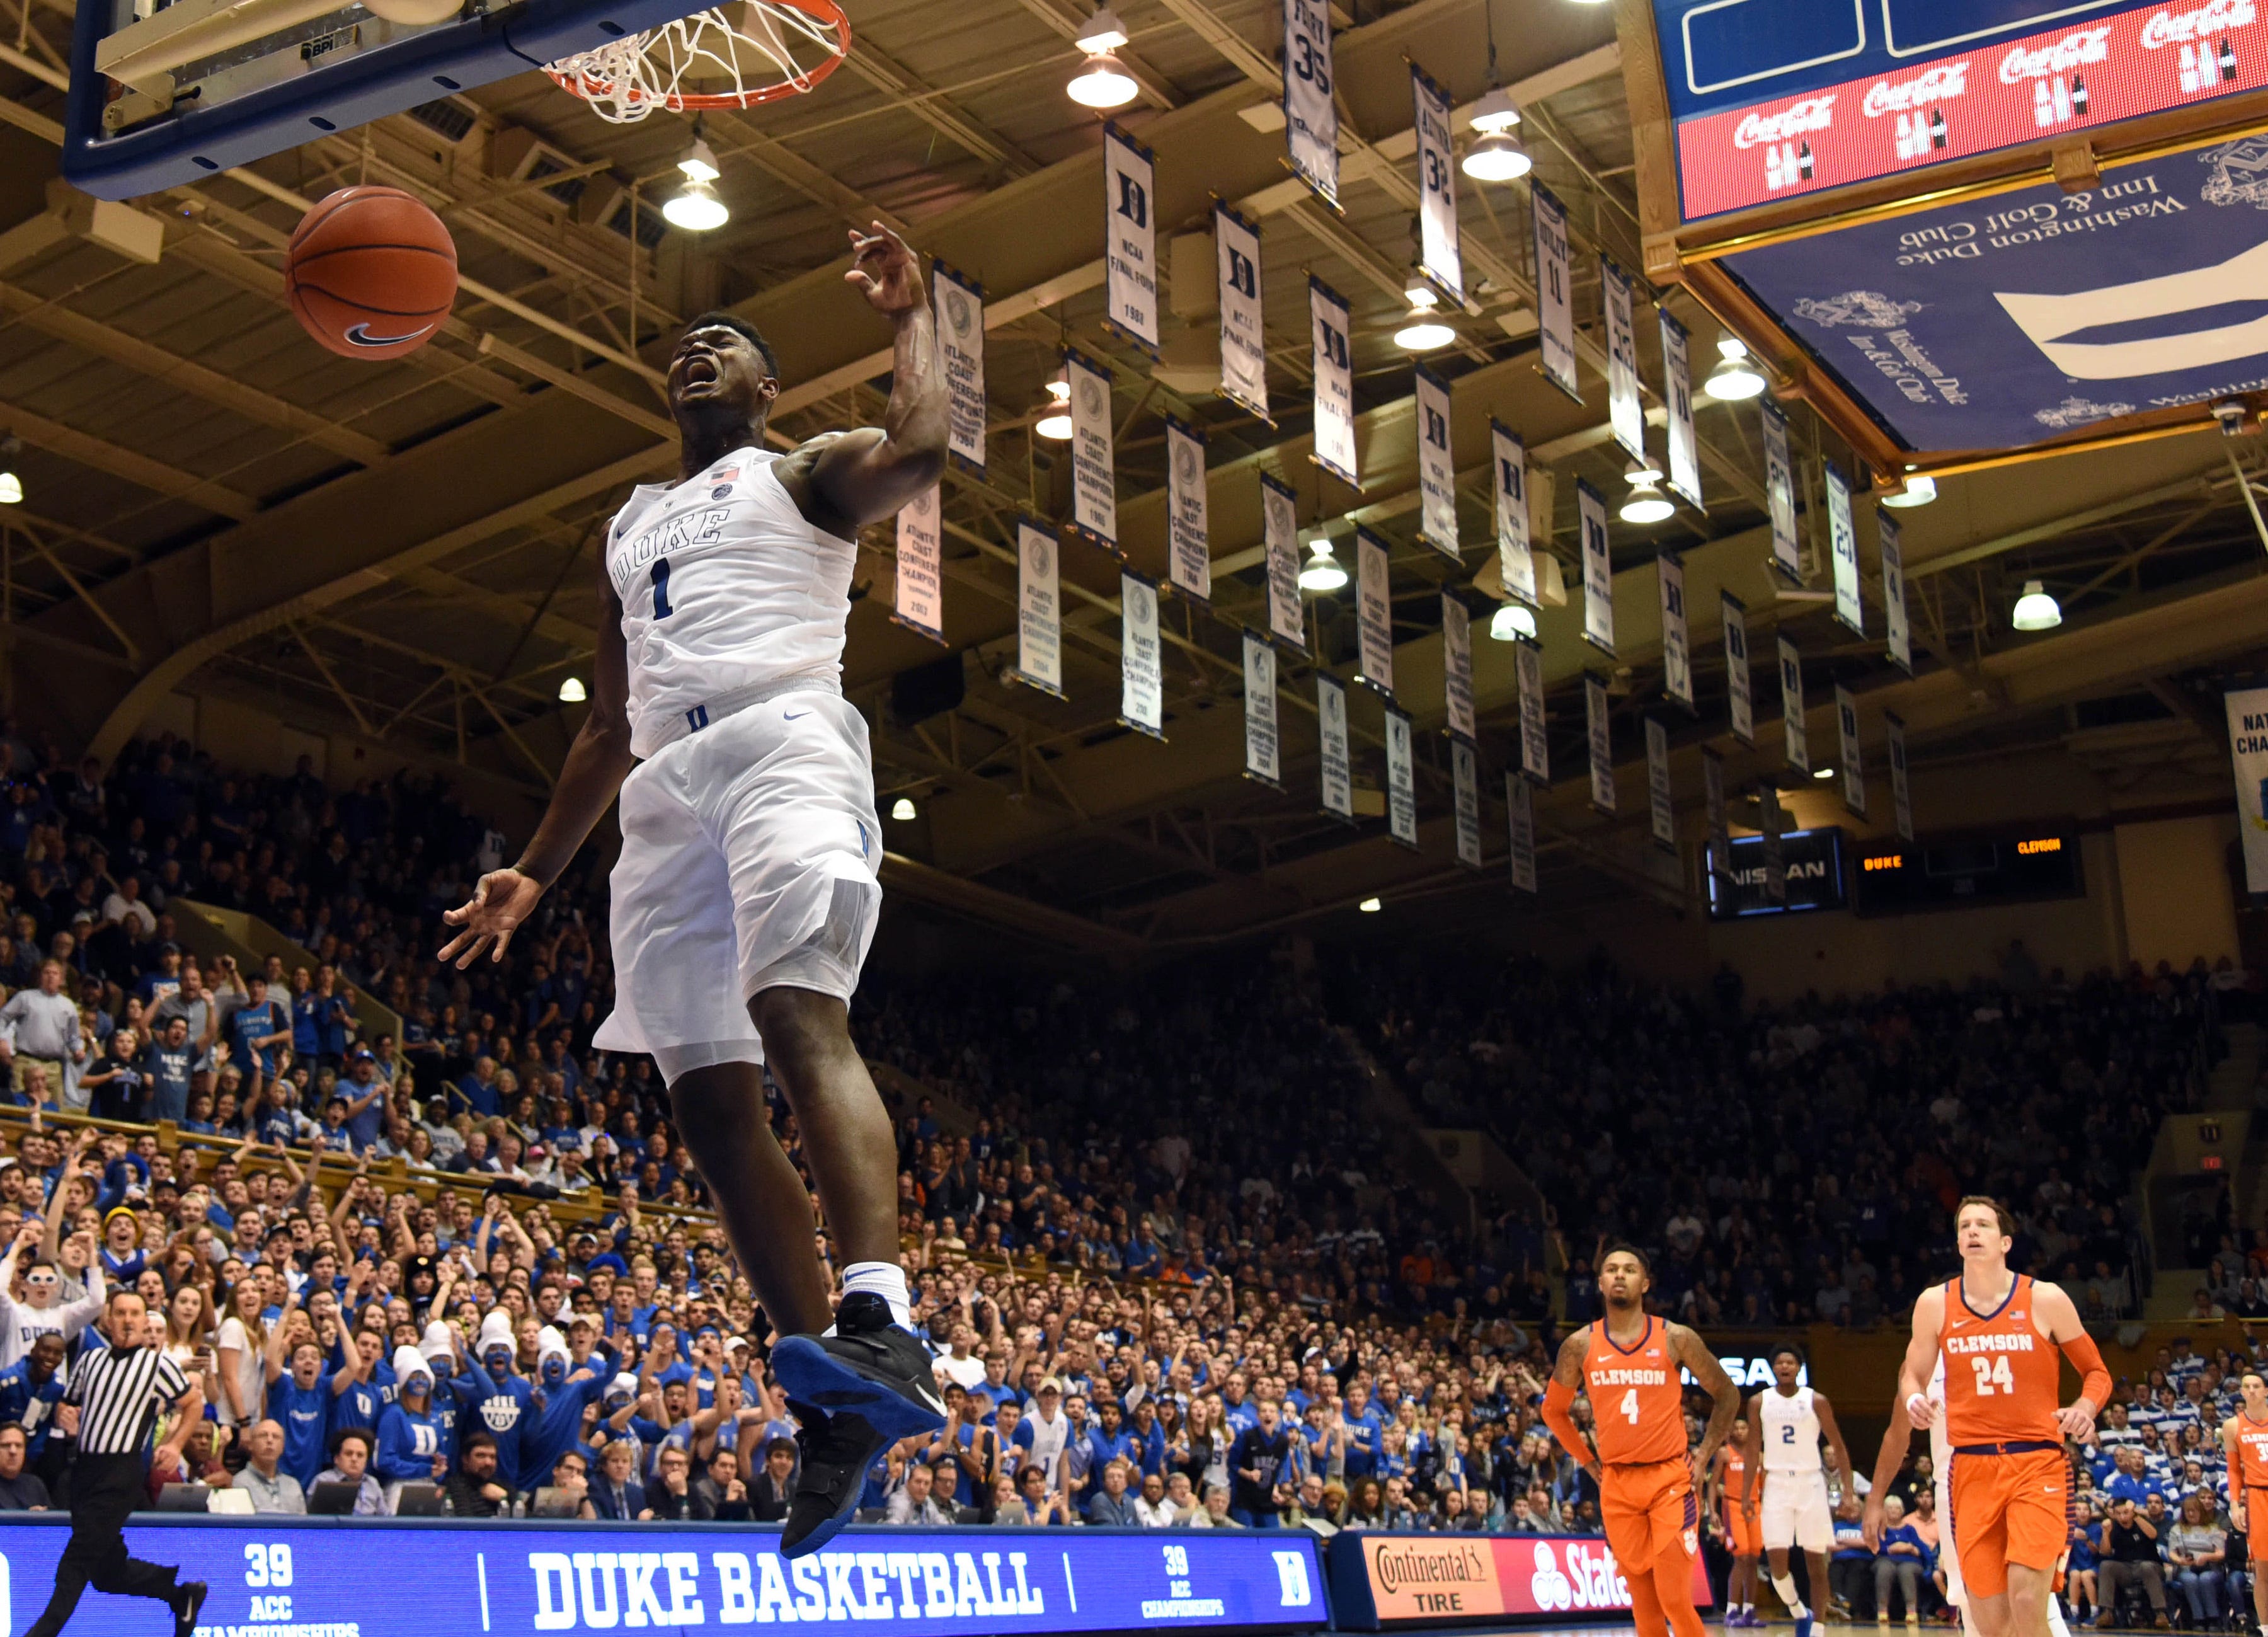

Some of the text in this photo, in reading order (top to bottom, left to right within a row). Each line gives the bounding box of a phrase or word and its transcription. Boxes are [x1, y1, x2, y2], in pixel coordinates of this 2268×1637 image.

[1999, 26, 2109, 83] Coca-Cola
[1863, 60, 1969, 117] Coca-Cola
[1734, 95, 1836, 148] Coca-Cola
[1896, 195, 2188, 266] Washington Duke
[1900, 176, 2162, 248] Inn & Golf Club
[612, 509, 730, 594] DUKE
[650, 557, 673, 621] 1
[1864, 854, 1903, 871] DUKE
[2017, 837, 2061, 854] CLEMSON
[1730, 860, 1825, 886] NISAN
[1947, 1334, 2034, 1353] CLEMSON
[1590, 1369, 1666, 1386] CLEMSON
[1971, 1355, 2013, 1396] 24
[1620, 1388, 1639, 1425] 4
[1782, 1425, 1795, 1444] 2
[244, 1544, 293, 1587] 39
[1162, 1545, 1189, 1576] 39
[1375, 1544, 1472, 1594] Continental
[529, 1552, 1044, 1630] DUKE BASKETBALL
[1169, 1581, 1192, 1597] ACC
[1413, 1592, 1463, 1612] TIRE
[249, 1596, 292, 1620] ACC
[1142, 1599, 1225, 1619] CHAMPIONSHIPS
